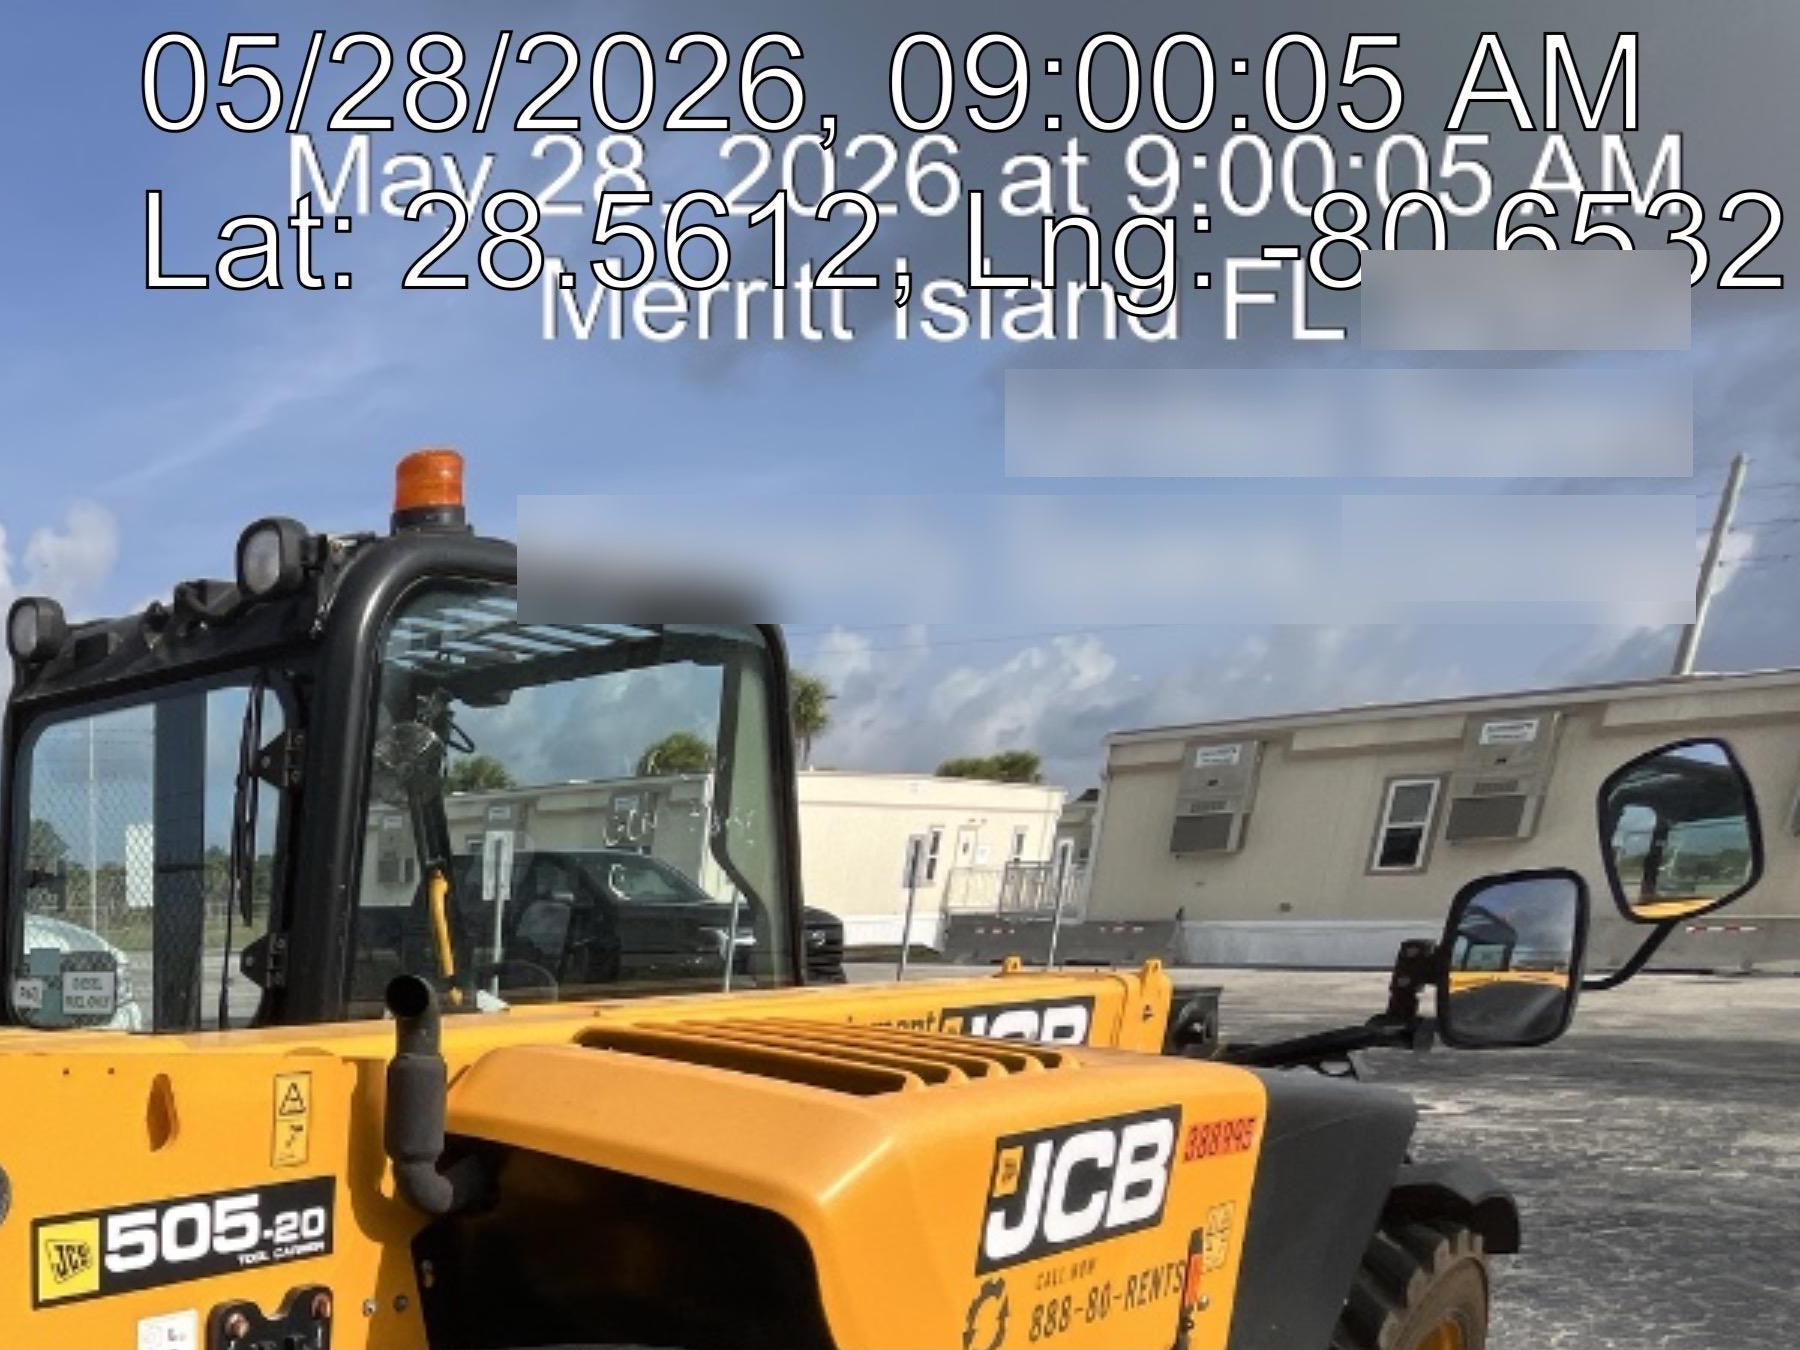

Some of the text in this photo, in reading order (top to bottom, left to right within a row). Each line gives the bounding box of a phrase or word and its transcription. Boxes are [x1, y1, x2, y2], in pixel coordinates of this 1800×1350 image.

[986, 1118, 1175, 1260] JCB
[104, 1193, 326, 1273] 505-20
[1029, 1259, 1187, 1342] 888-80-RENTS
